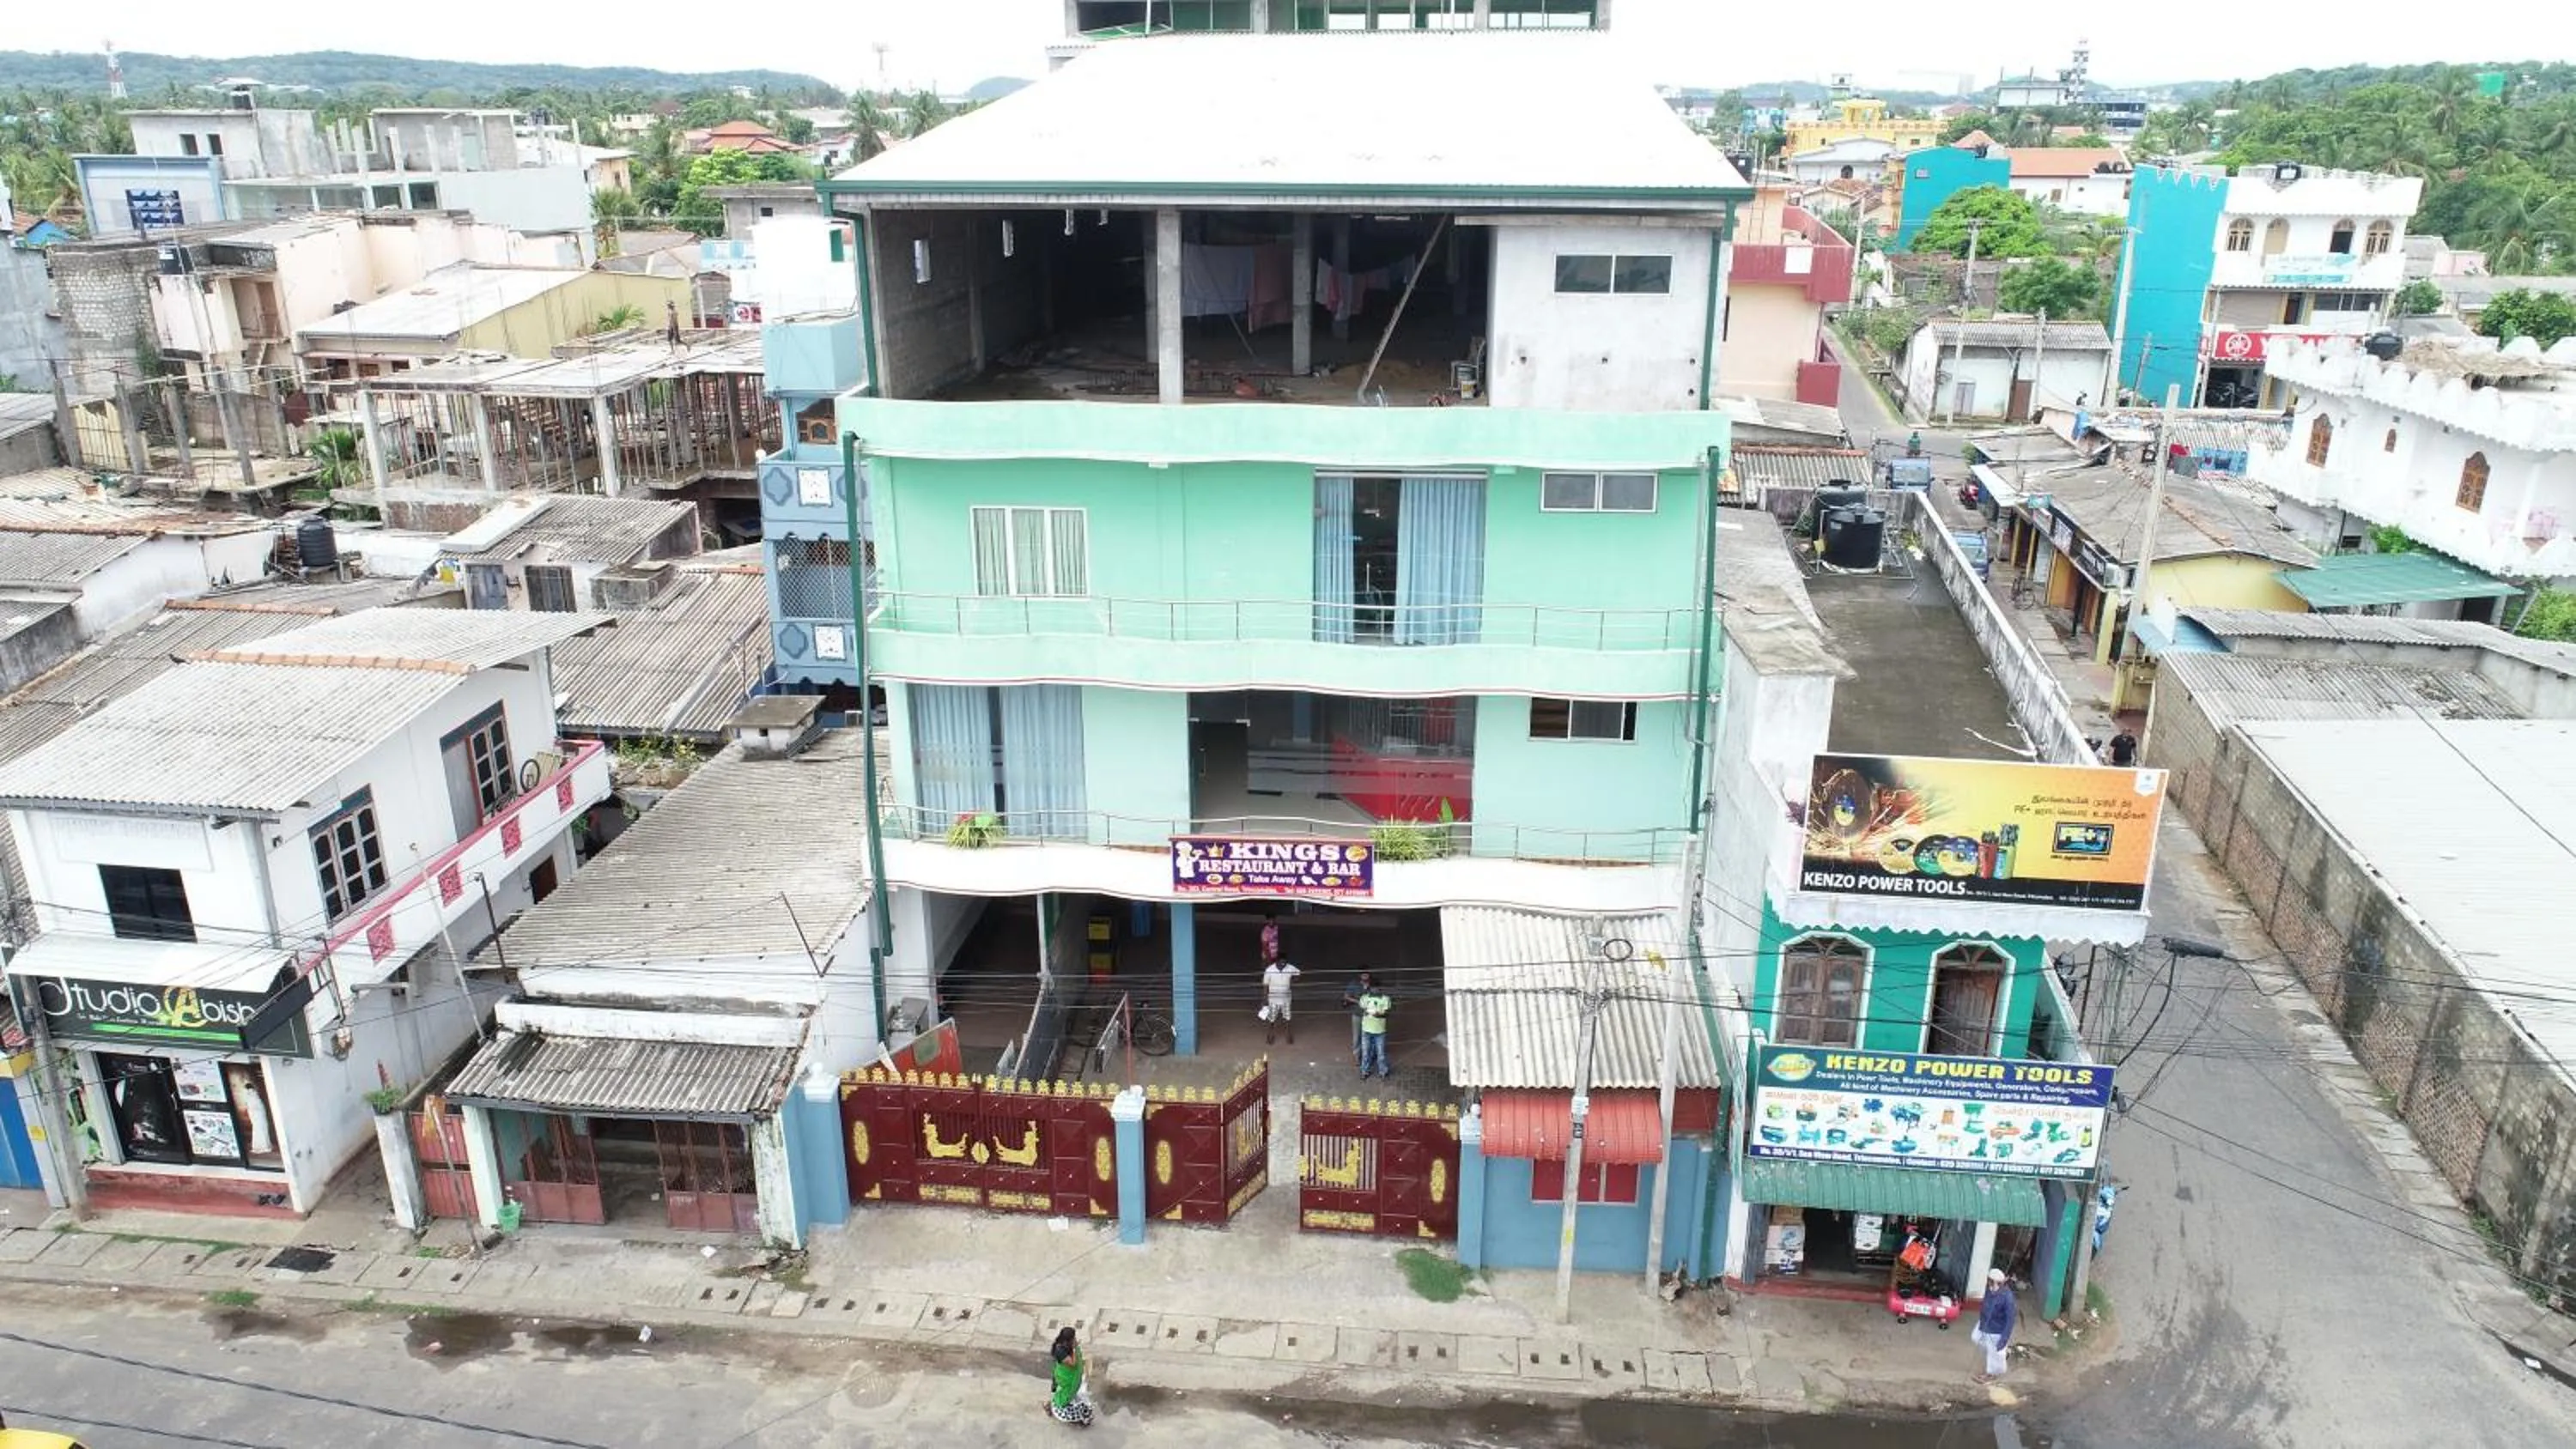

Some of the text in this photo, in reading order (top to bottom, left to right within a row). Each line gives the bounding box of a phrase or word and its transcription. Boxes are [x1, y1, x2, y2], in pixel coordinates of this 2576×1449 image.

[1230, 842, 1340, 861] KINGS
[1199, 859, 1361, 876] RESTAURANT & BAR
[1249, 875, 1297, 885] Take Away
[1804, 871, 1856, 889] KENZO
[1858, 875, 1913, 893] POWER
[1916, 879, 1966, 895] TOOLS
[1826, 1054, 1906, 1073] KENZO
[1916, 1060, 2005, 1079] POWER
[2014, 1066, 2093, 1084] TOOLS
